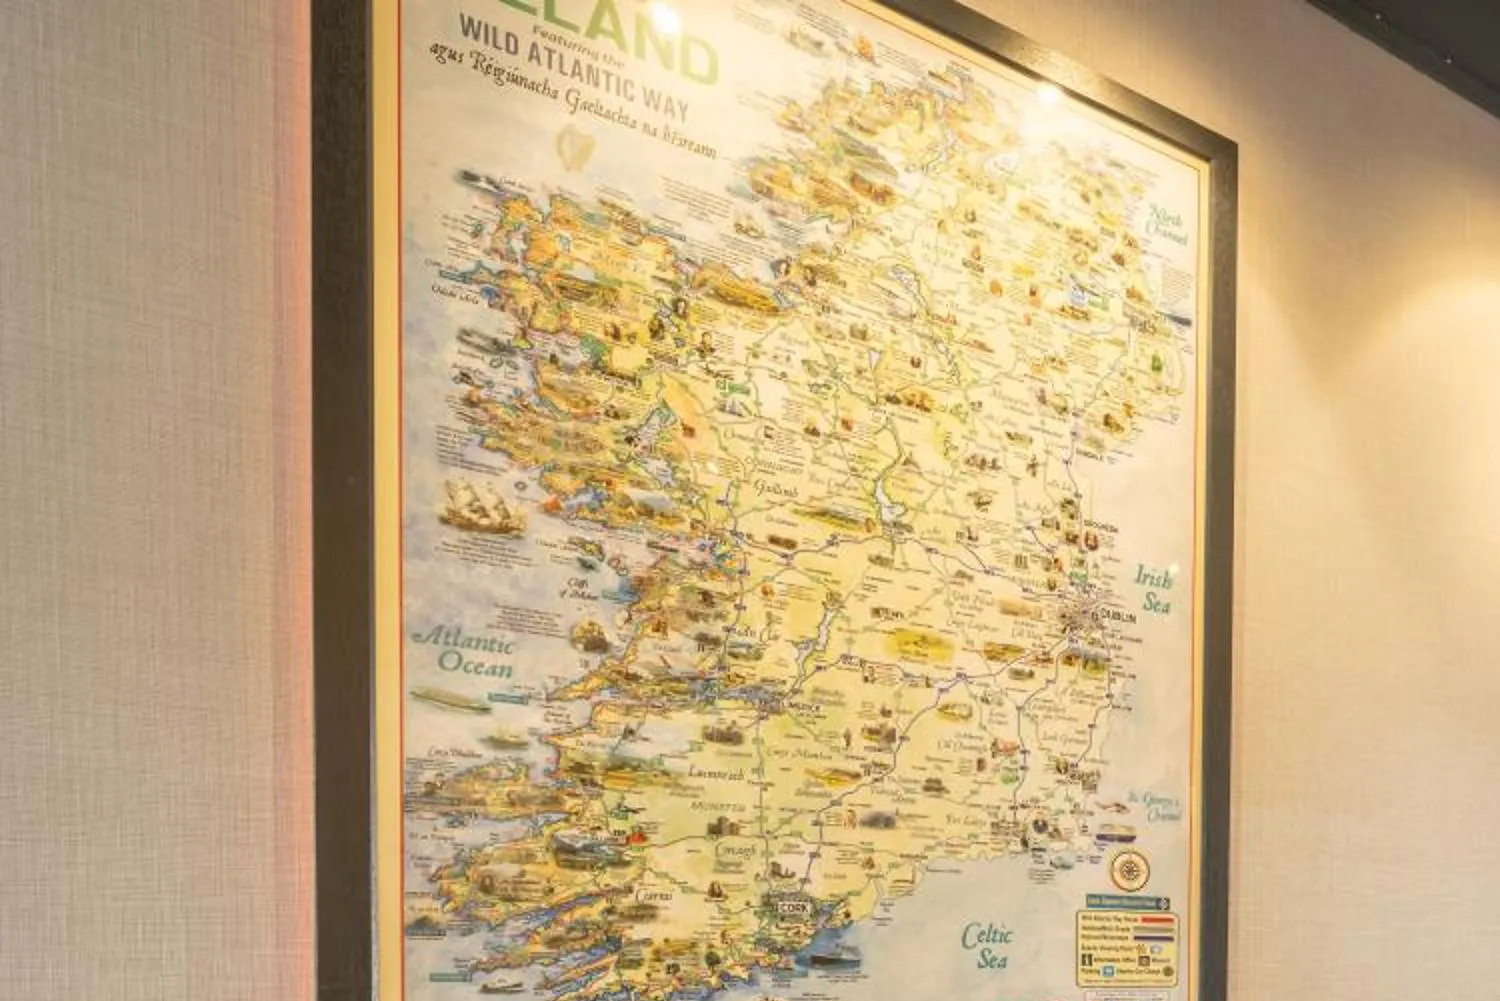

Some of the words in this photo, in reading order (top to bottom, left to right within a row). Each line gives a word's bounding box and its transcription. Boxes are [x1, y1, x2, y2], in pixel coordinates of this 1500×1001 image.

[429, 39, 465, 65] agus
[498, 0, 719, 86] LAND
[459, 11, 519, 55] WILD
[527, 40, 636, 102] ATLANTIC
[641, 85, 690, 123] WAY
[1133, 562, 1174, 591] Irish
[1142, 590, 1172, 615] Sea
[410, 622, 518, 655] Atlantic
[437, 650, 514, 680] Ocean
[960, 919, 1017, 951] Celtic
[976, 946, 1010, 971] Sea
